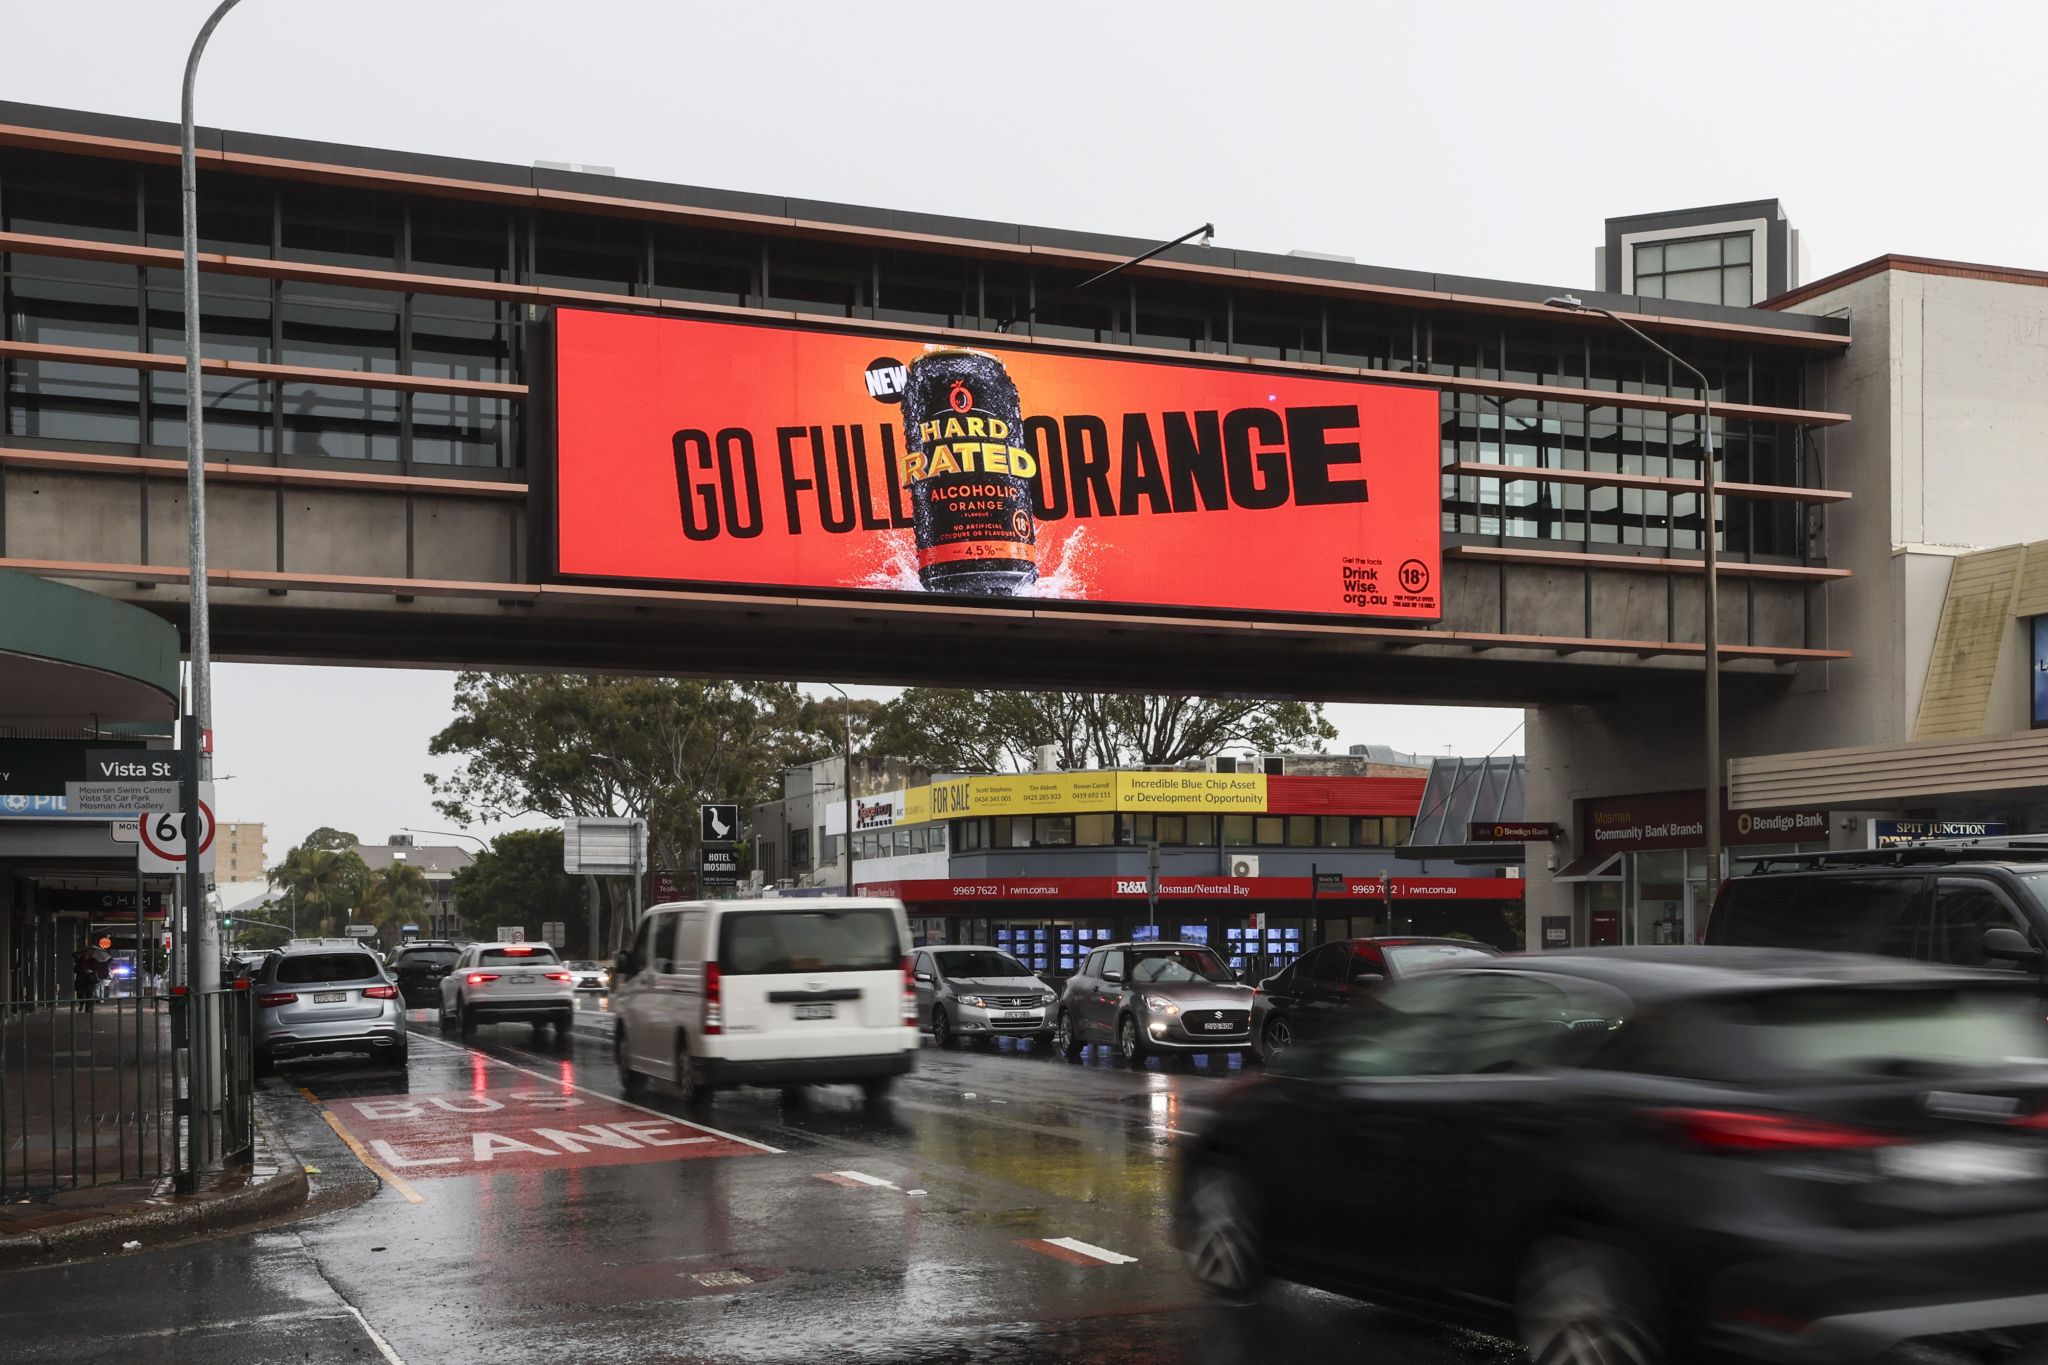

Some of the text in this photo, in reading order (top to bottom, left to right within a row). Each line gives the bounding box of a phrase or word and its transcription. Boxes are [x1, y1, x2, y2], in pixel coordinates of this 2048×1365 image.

[865, 365, 908, 397] NEW
[919, 416, 1009, 443] HARD
[901, 442, 1037, 488] RATED
[672, 404, 1369, 541] GO FULL ORANGE
[930, 485, 1018, 501] ALCOHOLIC
[949, 501, 1004, 512] ORANGE
[966, 523, 1003, 531] ARTIFICIAL
[940, 531, 970, 540] COLOURS
[965, 545, 996, 557] 4.5%
[1367, 558, 1383, 566] facts
[1343, 566, 1378, 580] Drink
[1402, 568, 1426, 585] 18+
[1343, 580, 1379, 594] Wise.
[1343, 594, 1388, 607] org.au
[100, 762, 171, 777] Vista St
[1131, 778, 1256, 790] Incredible Blue Chip Asset
[932, 786, 948, 814] FOR
[950, 783, 970, 811] SALE
[1124, 792, 1263, 805] or Development Opportunity
[134, 802, 164, 811] Gallery
[1595, 811, 1631, 825] Mosman
[1753, 813, 1823, 831] Bendigo Bank
[1504, 828, 1531, 837] Bendigo
[1532, 828, 1549, 836] Bank
[1595, 821, 1703, 842] Community Bank Branch
[1896, 822, 1986, 836] SPIT JUNCTION
[708, 853, 731, 862] HOTEL
[703, 862, 736, 872] MOSMAN
[953, 886, 1058, 896] 9969 7622 rwm.com.au
[1233, 884, 1250, 896] Bay
[1352, 885, 1375, 894] 9969
[1376, 885, 1397, 894] 762
[1409, 885, 1457, 894] rwm.com.au
[352, 1090, 585, 1121] BUS
[369, 1119, 718, 1169] LANE
